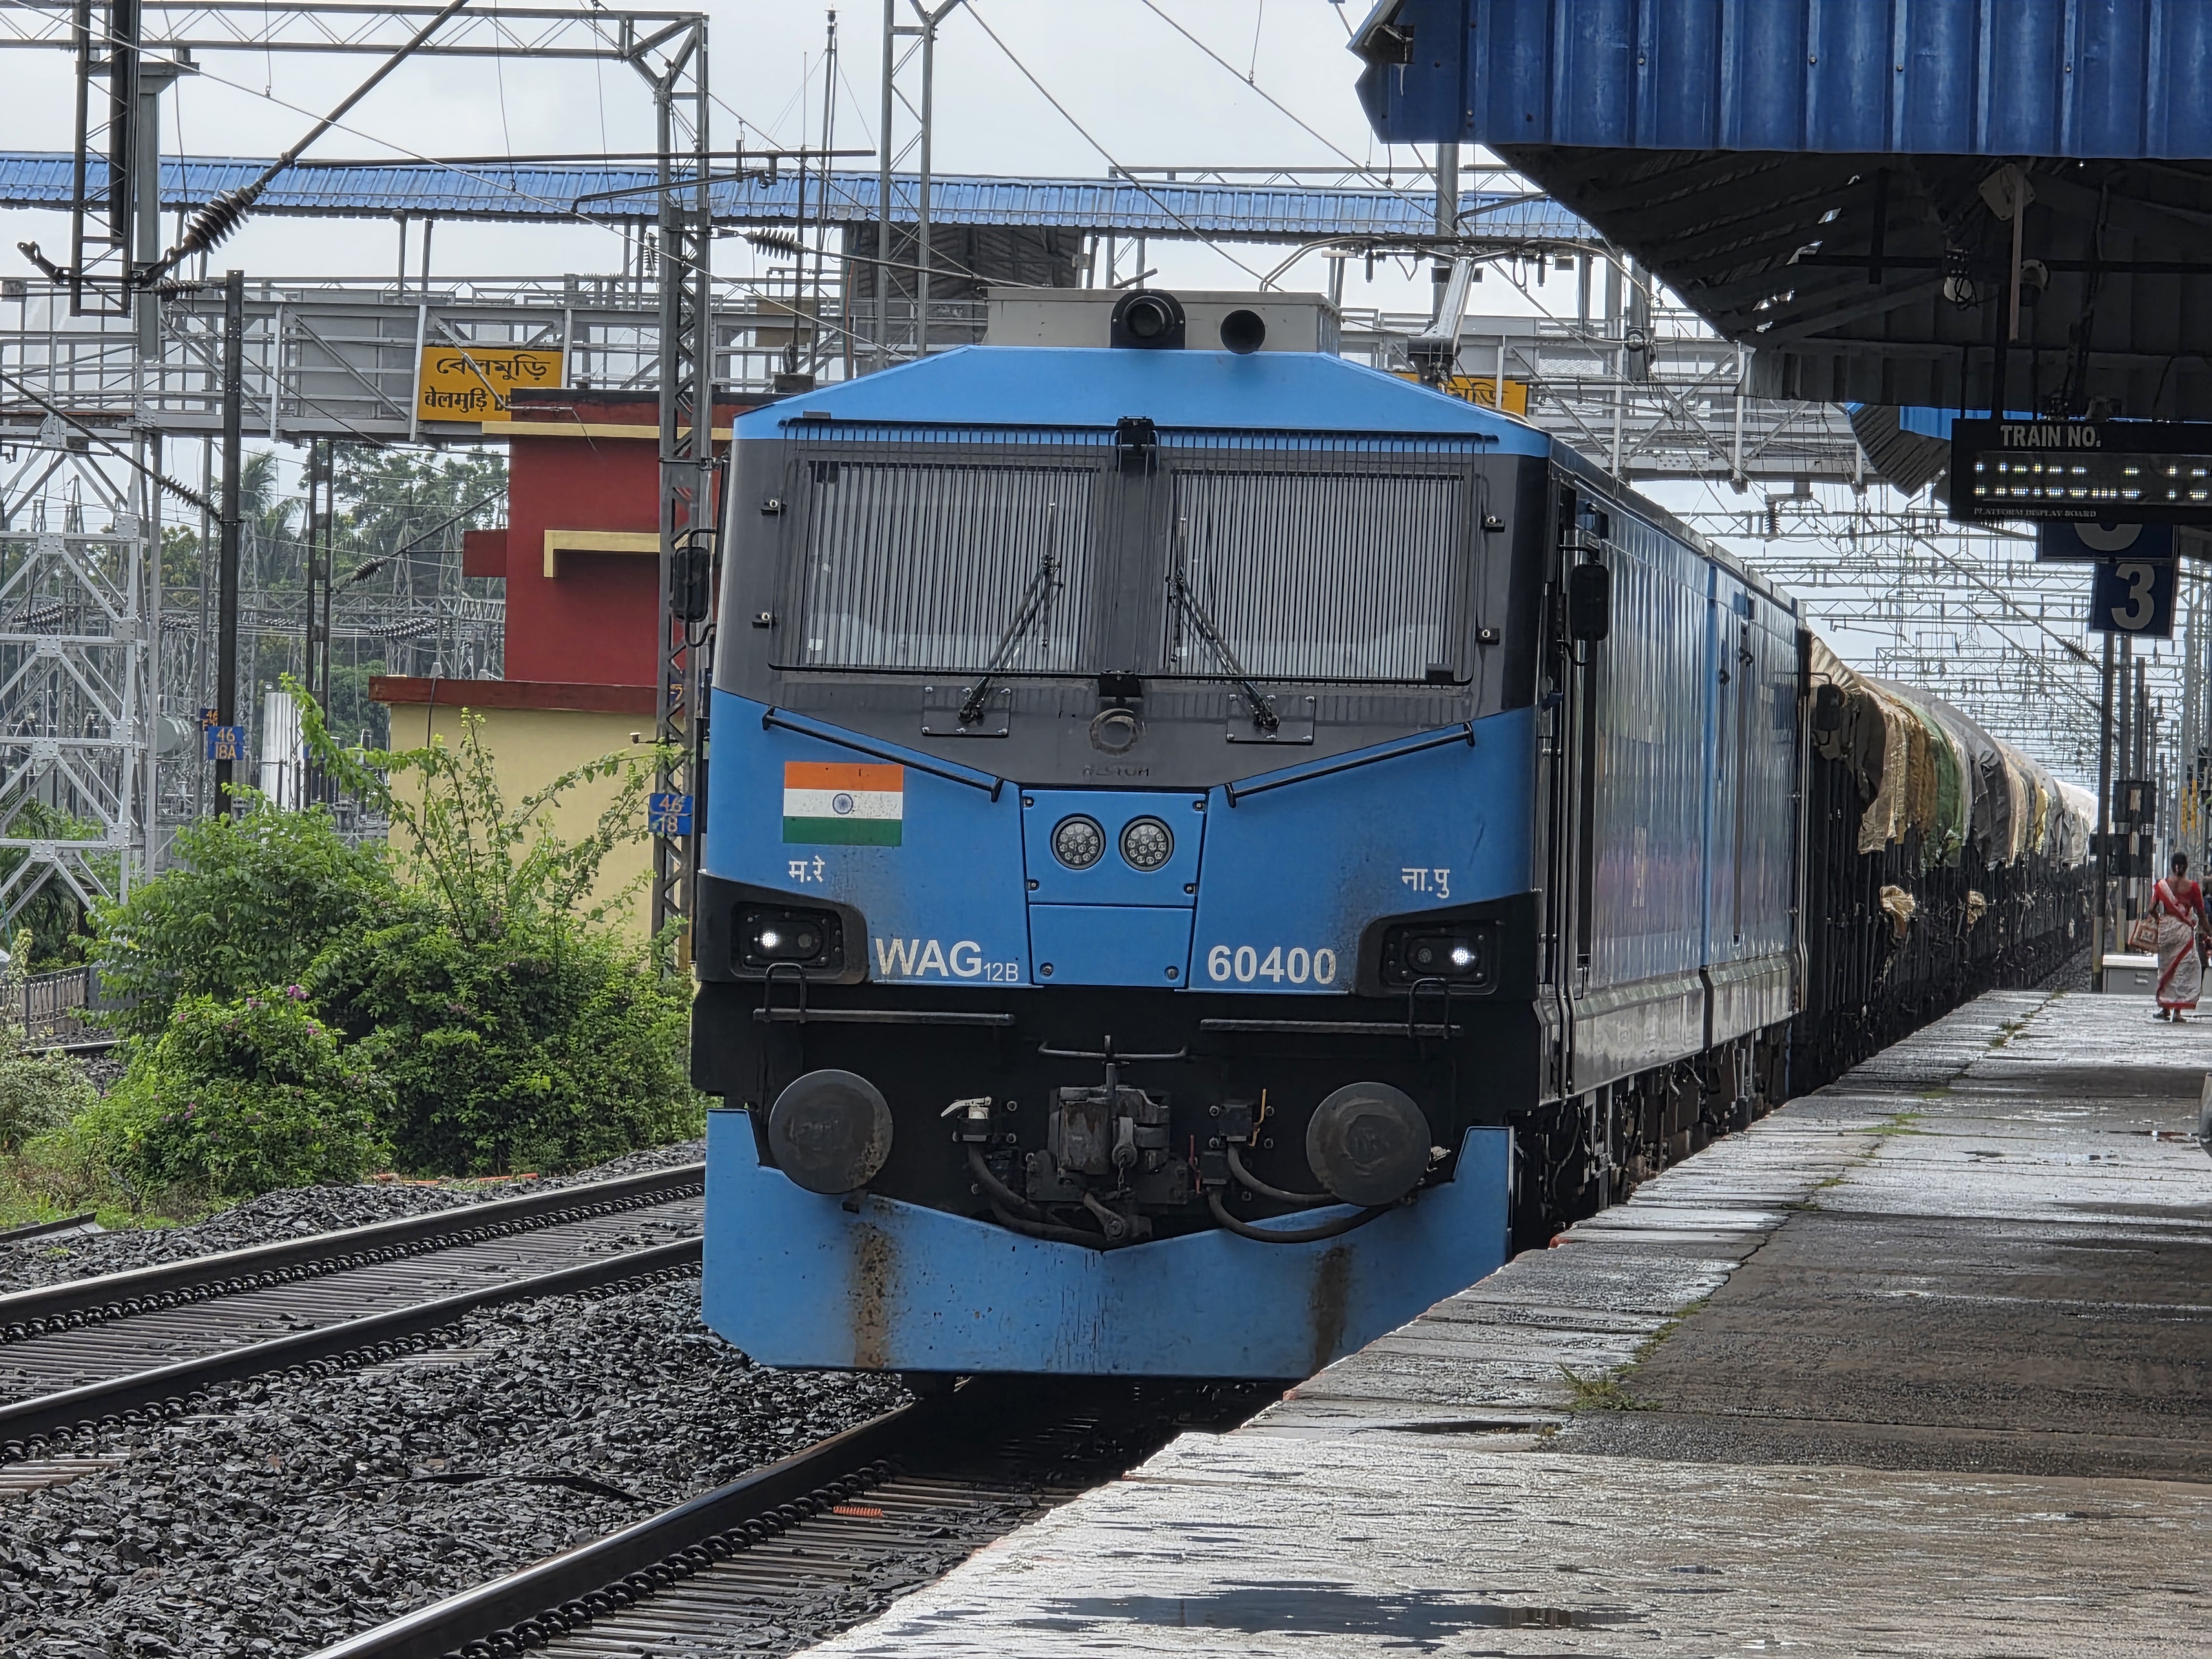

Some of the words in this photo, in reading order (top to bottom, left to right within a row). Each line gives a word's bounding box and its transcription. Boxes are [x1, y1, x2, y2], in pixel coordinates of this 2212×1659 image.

[2000, 425, 2061, 447] TRAIN
[2068, 426, 2101, 447] NO.
[1974, 507, 2023, 516] PLATFORM
[2111, 563, 2154, 630] 3
[217, 727, 235, 742] 46
[215, 744, 237, 759] 18A
[659, 795, 682, 812] 46
[661, 815, 678, 832] 18
[875, 938, 982, 977] WAG
[983, 962, 1018, 982] 12B
[1208, 945, 1336, 984] 60400
